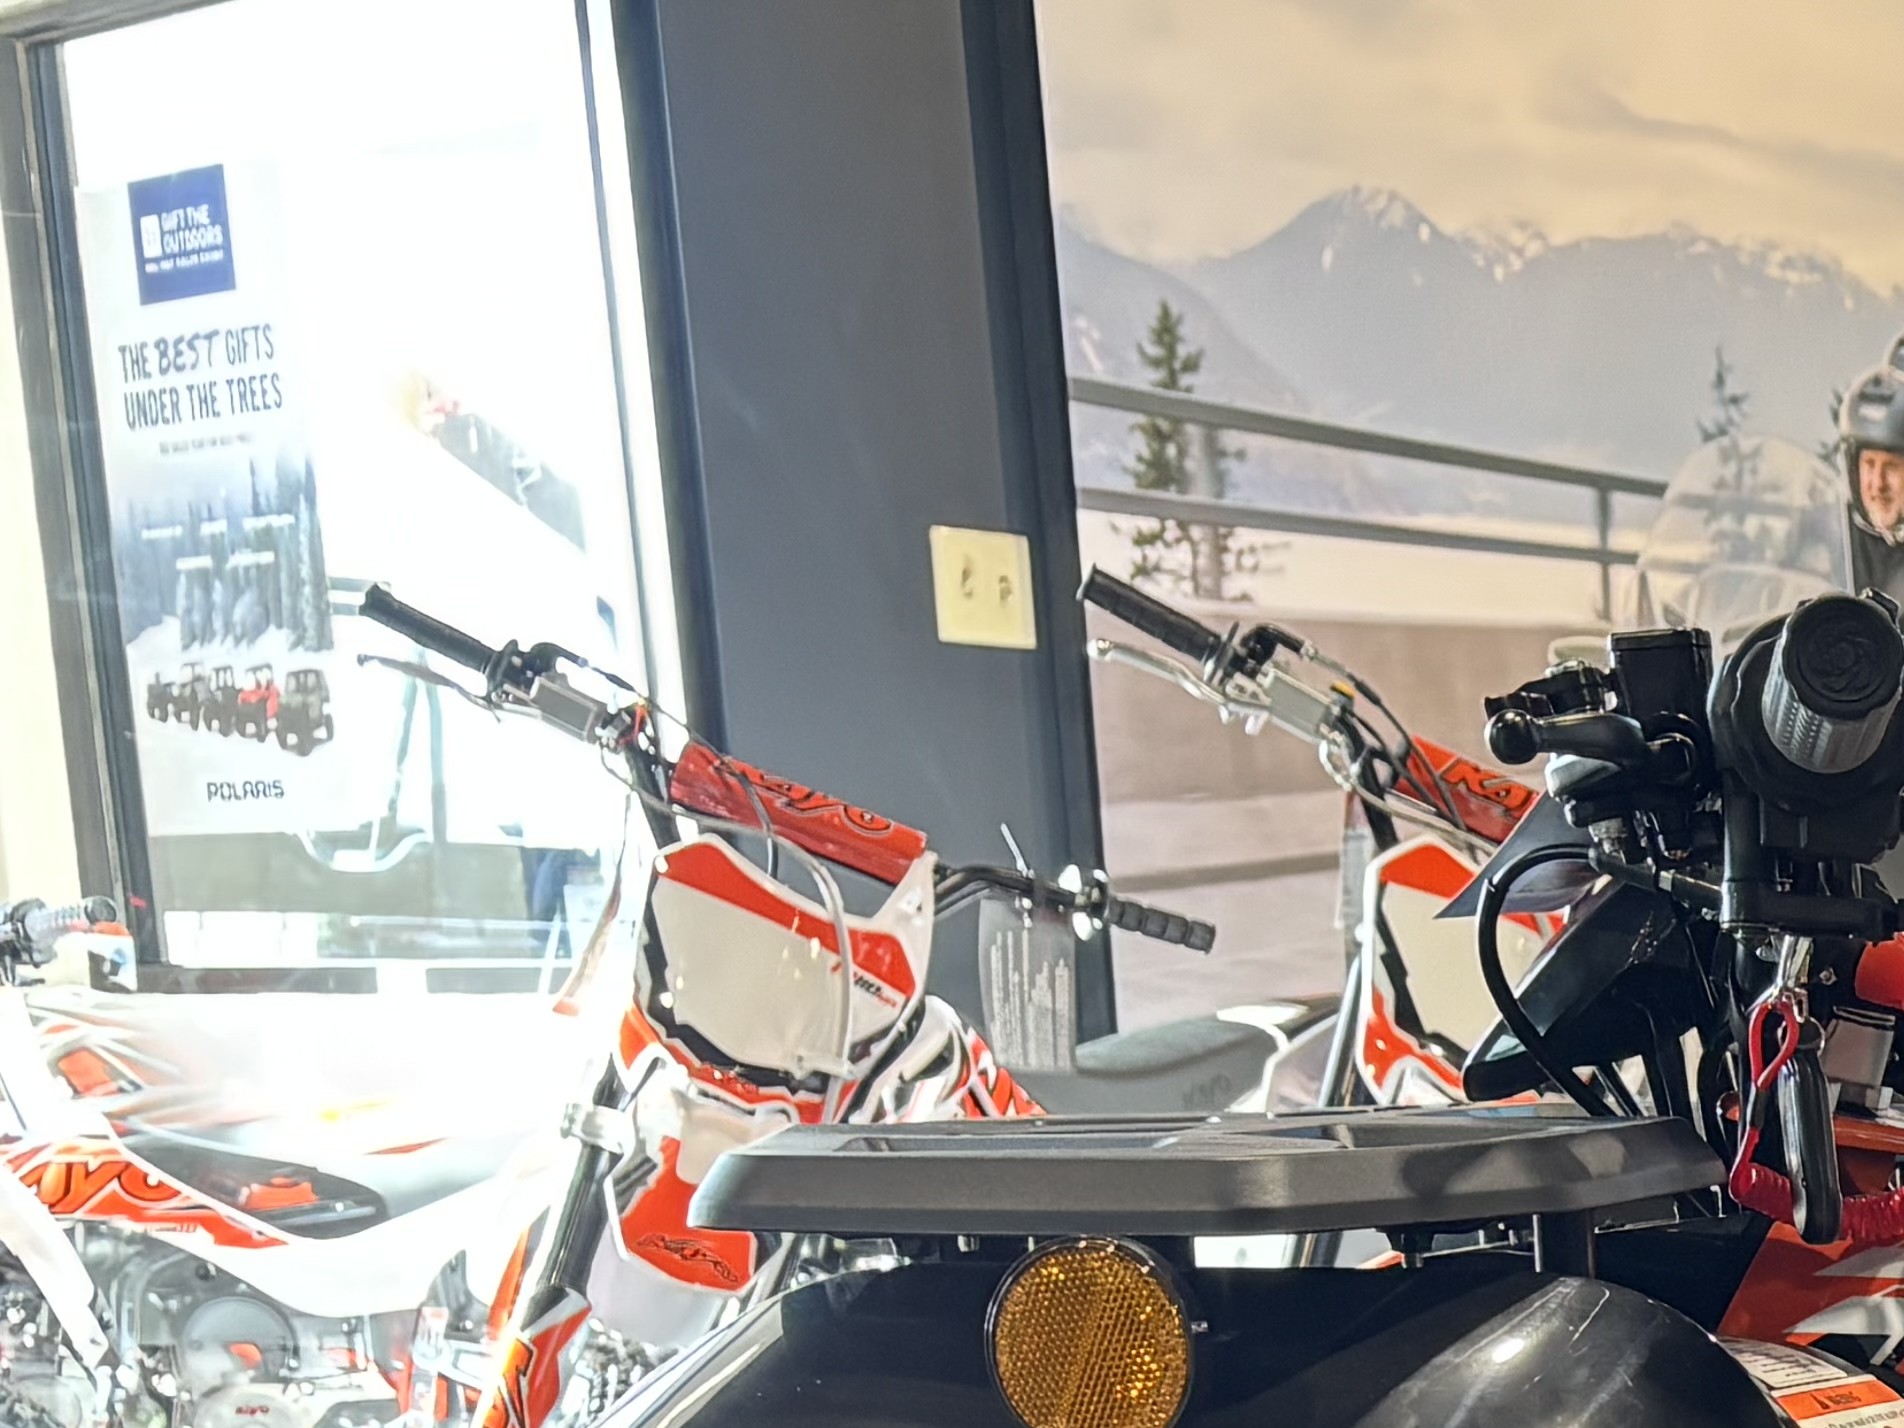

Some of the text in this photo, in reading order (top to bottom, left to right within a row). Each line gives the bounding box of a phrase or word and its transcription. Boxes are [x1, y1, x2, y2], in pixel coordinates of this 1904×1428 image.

[118, 323, 274, 384] THE BEST GIFTS
[124, 372, 283, 431] UNDER THE TREES
[207, 779, 285, 802] POLARIS
